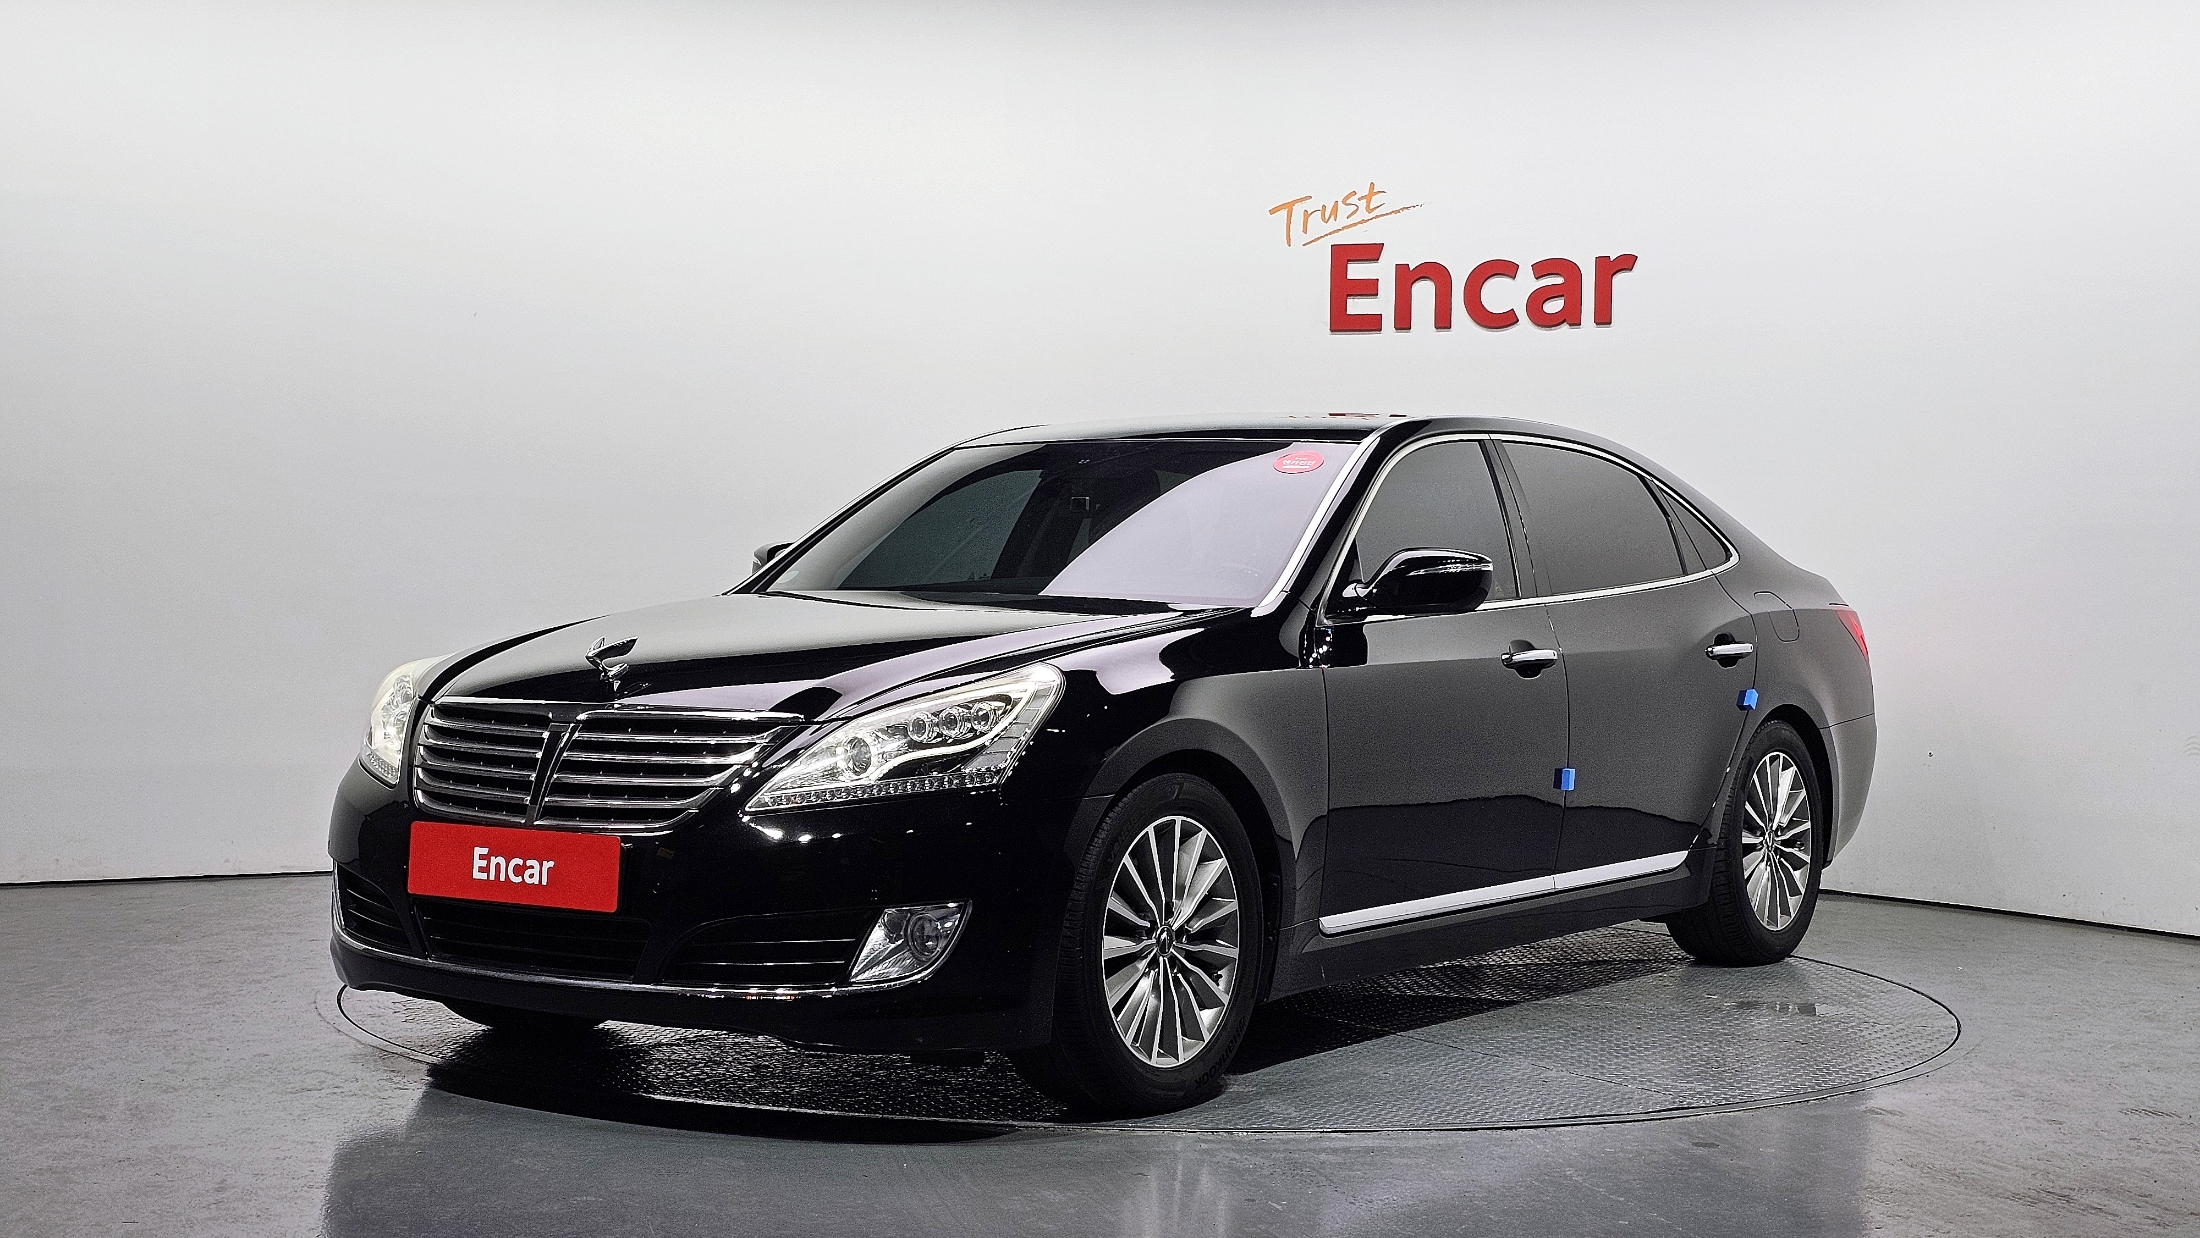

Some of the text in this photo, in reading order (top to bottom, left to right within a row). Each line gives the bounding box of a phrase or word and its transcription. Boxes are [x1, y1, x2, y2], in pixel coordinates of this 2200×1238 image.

[1268, 182, 1387, 247] Trust
[1329, 243, 1638, 333] Encar
[472, 846, 555, 886] Encar
